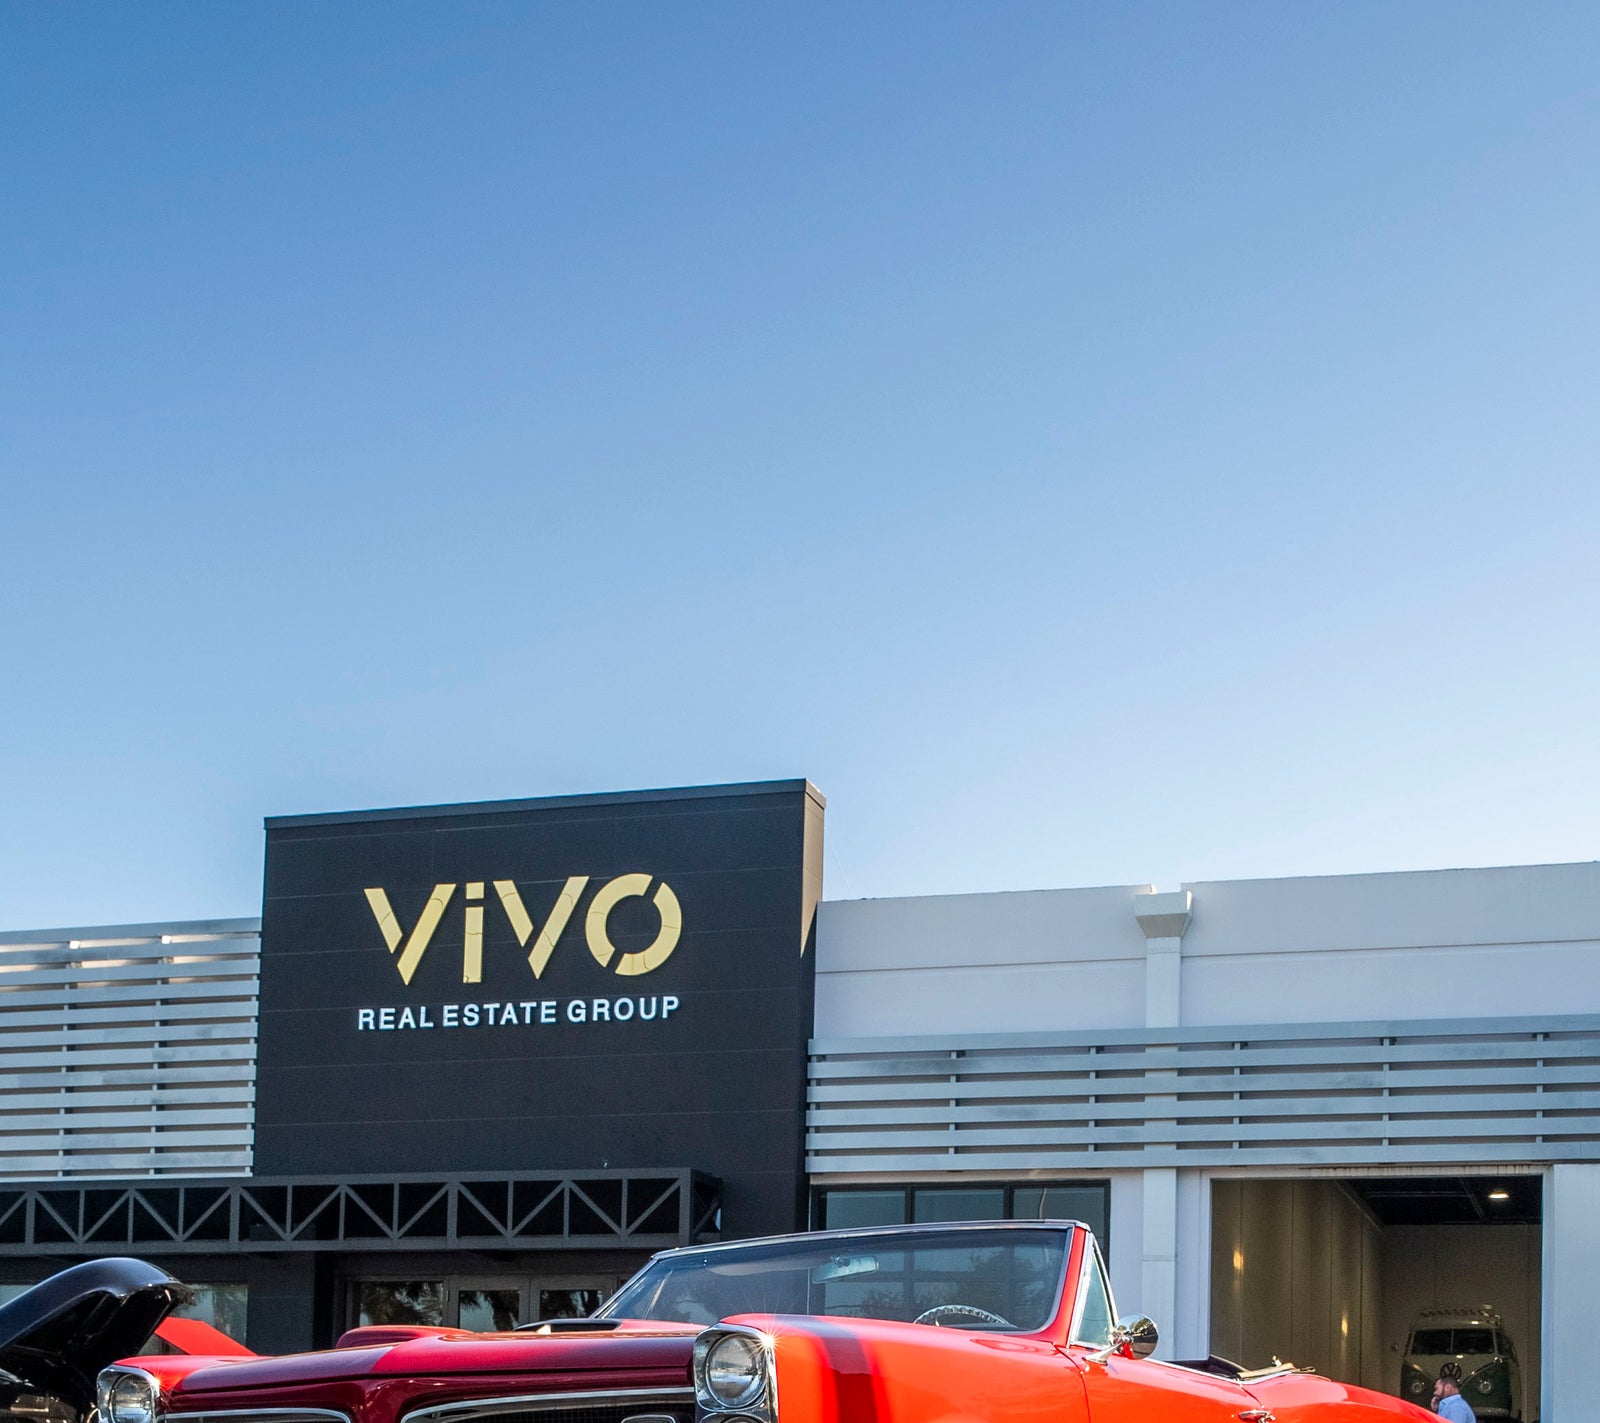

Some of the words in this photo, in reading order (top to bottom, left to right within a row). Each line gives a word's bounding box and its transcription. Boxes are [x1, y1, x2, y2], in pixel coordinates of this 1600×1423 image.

[358, 1006, 434, 1031] REAL
[442, 1001, 557, 1027] ESTATE
[566, 996, 680, 1023] GROUP
